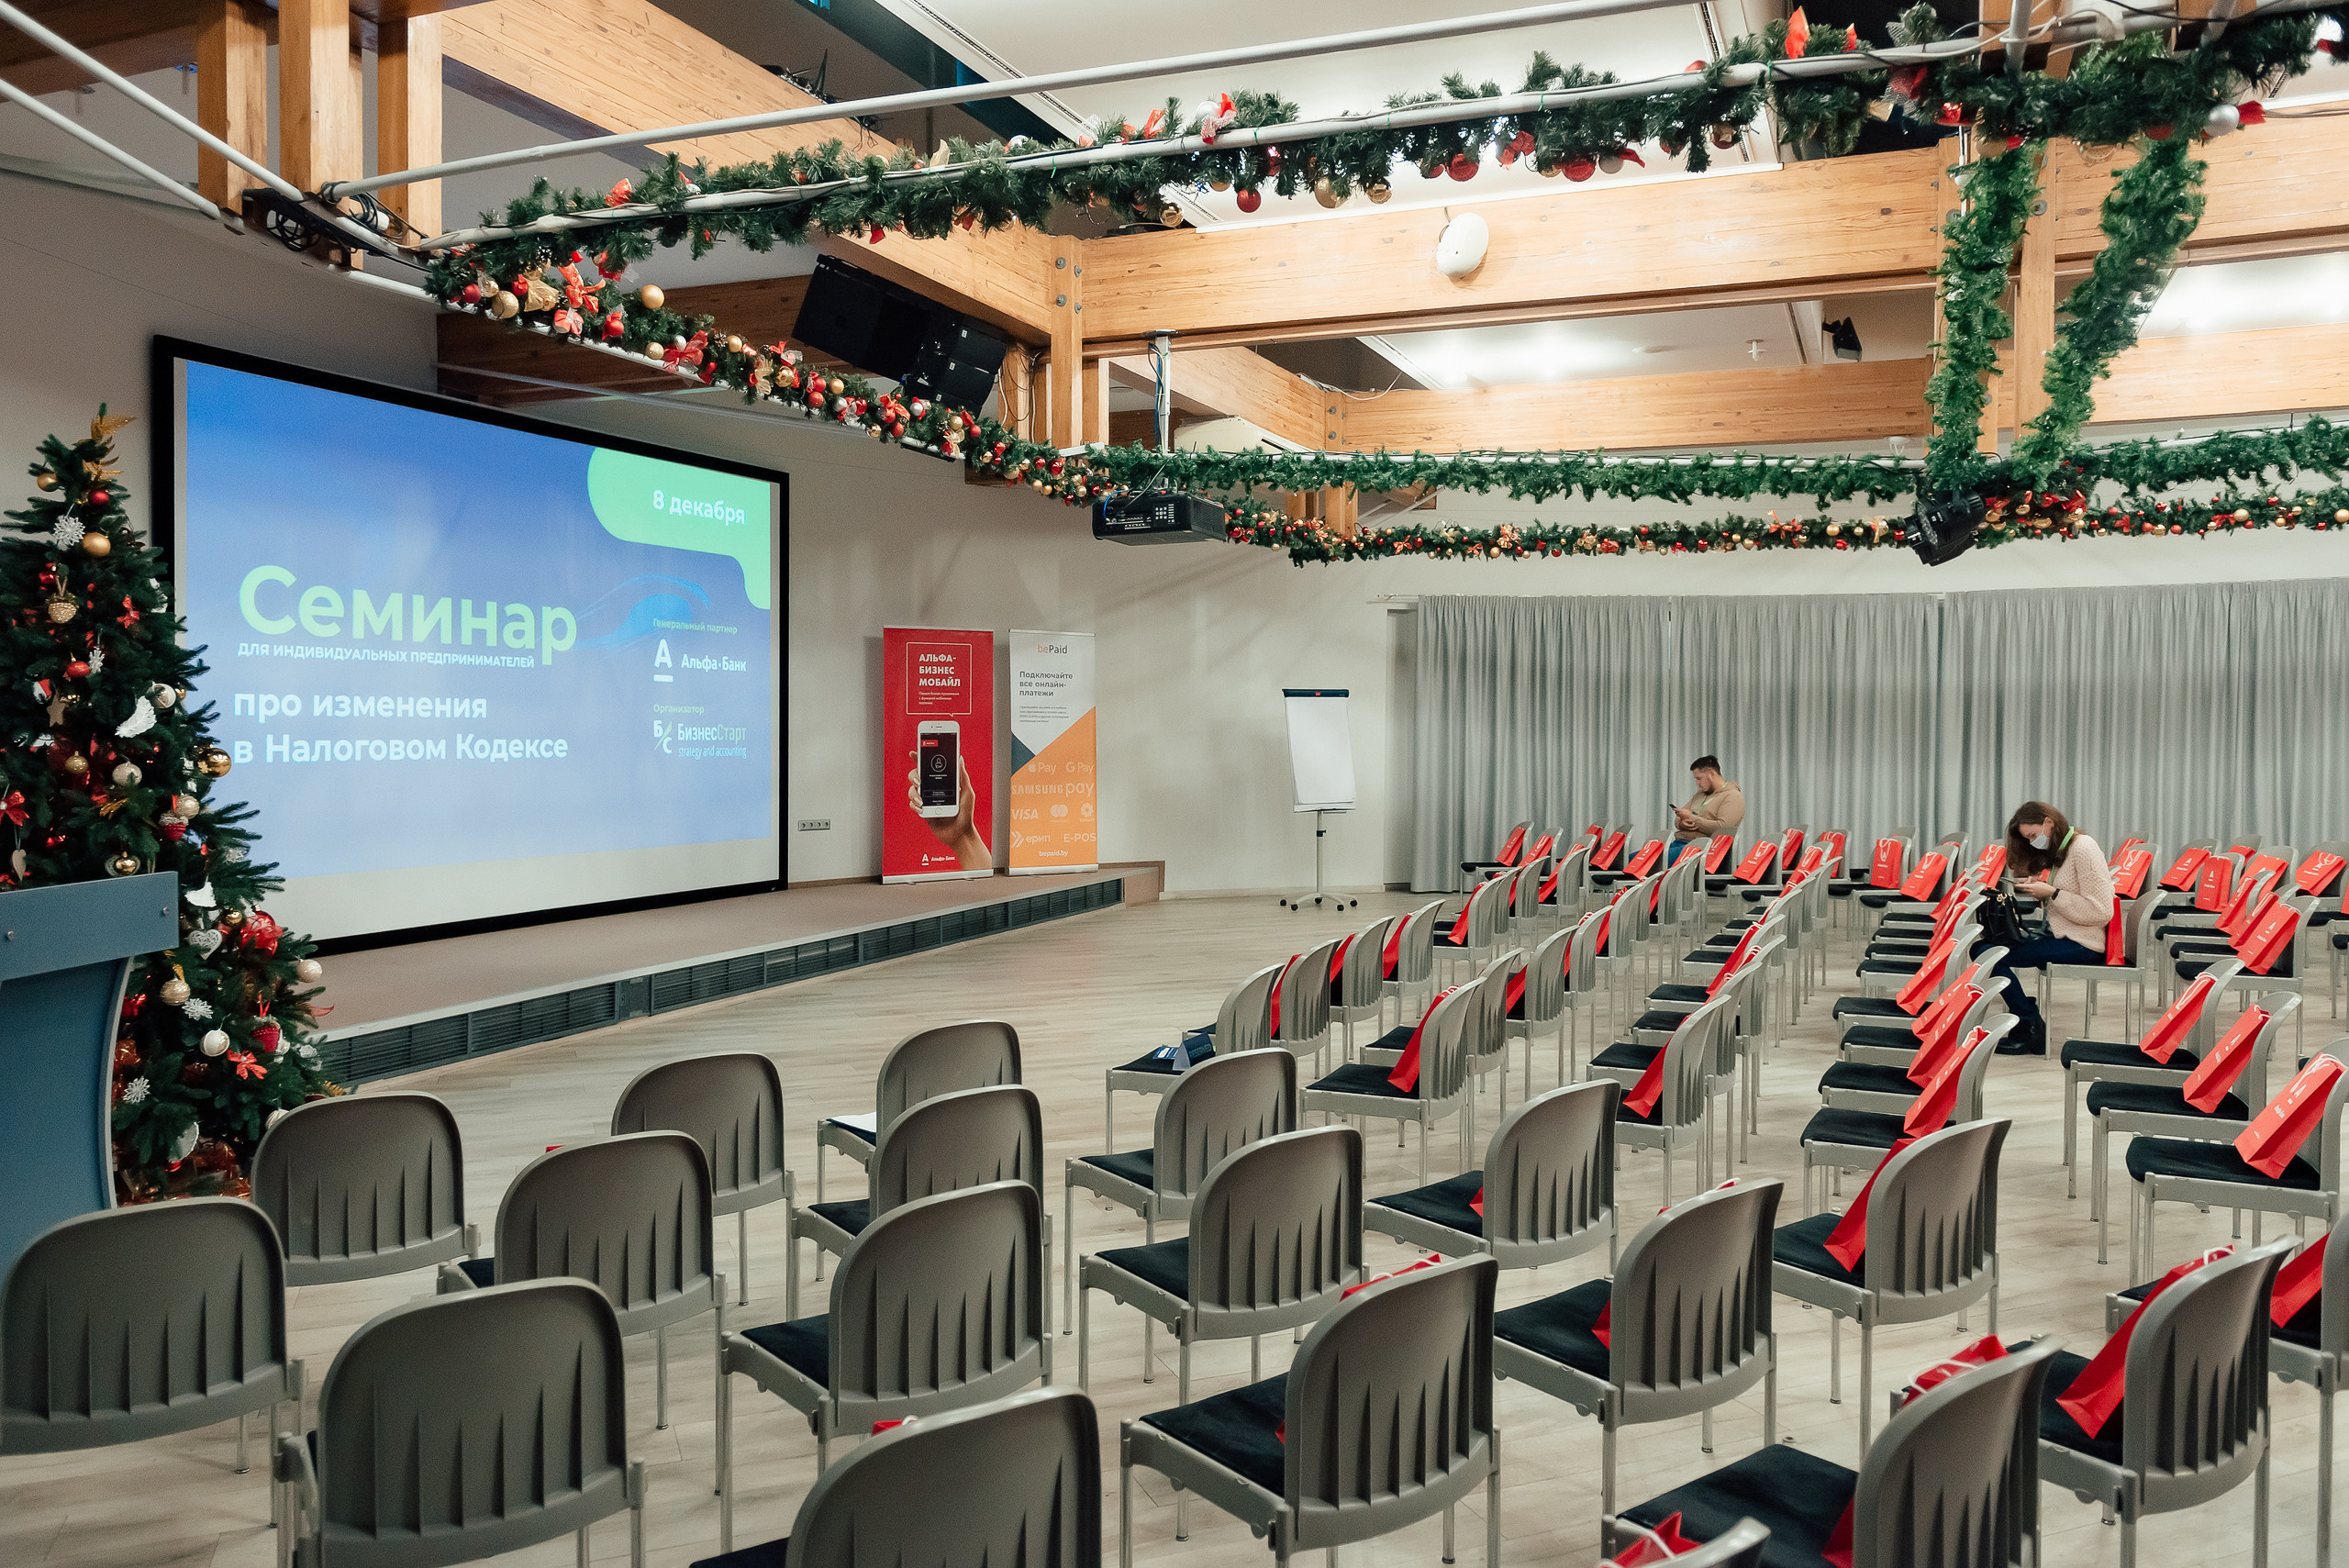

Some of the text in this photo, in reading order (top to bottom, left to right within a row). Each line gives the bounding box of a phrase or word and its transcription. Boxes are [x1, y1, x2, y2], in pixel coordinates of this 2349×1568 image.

[652, 489, 746, 527] 8 декабря
[239, 564, 577, 666] Семинар
[653, 617, 738, 636] Генеральный партнер
[1037, 644, 1068, 654] bePaid
[238, 642, 535, 669] ДЛЯ ИНДИВИДУАЛЬНЫХ ПРЕДПРИНИМАТЕЛЕЙ
[918, 653, 957, 662] АЛЬФА-
[918, 665, 955, 675] БИЗНЕС
[1019, 671, 1074, 680] Подключайте
[918, 676, 961, 687] МОБАЙЛ
[234, 693, 488, 724] про изменения
[652, 704, 705, 716] Организатор
[677, 723, 747, 744] БизнесСтарт
[234, 734, 569, 763] в Налоговом Кодексе
[678, 745, 747, 760] strategy and accounting
[1038, 762, 1057, 774] Pay
[1065, 762, 1095, 774] G Pay
[1011, 782, 1095, 797] SAMSUNG pay
[1011, 808, 1039, 820] VISA
[1026, 834, 1051, 844] ерип
[1063, 832, 1097, 842] E-POS
